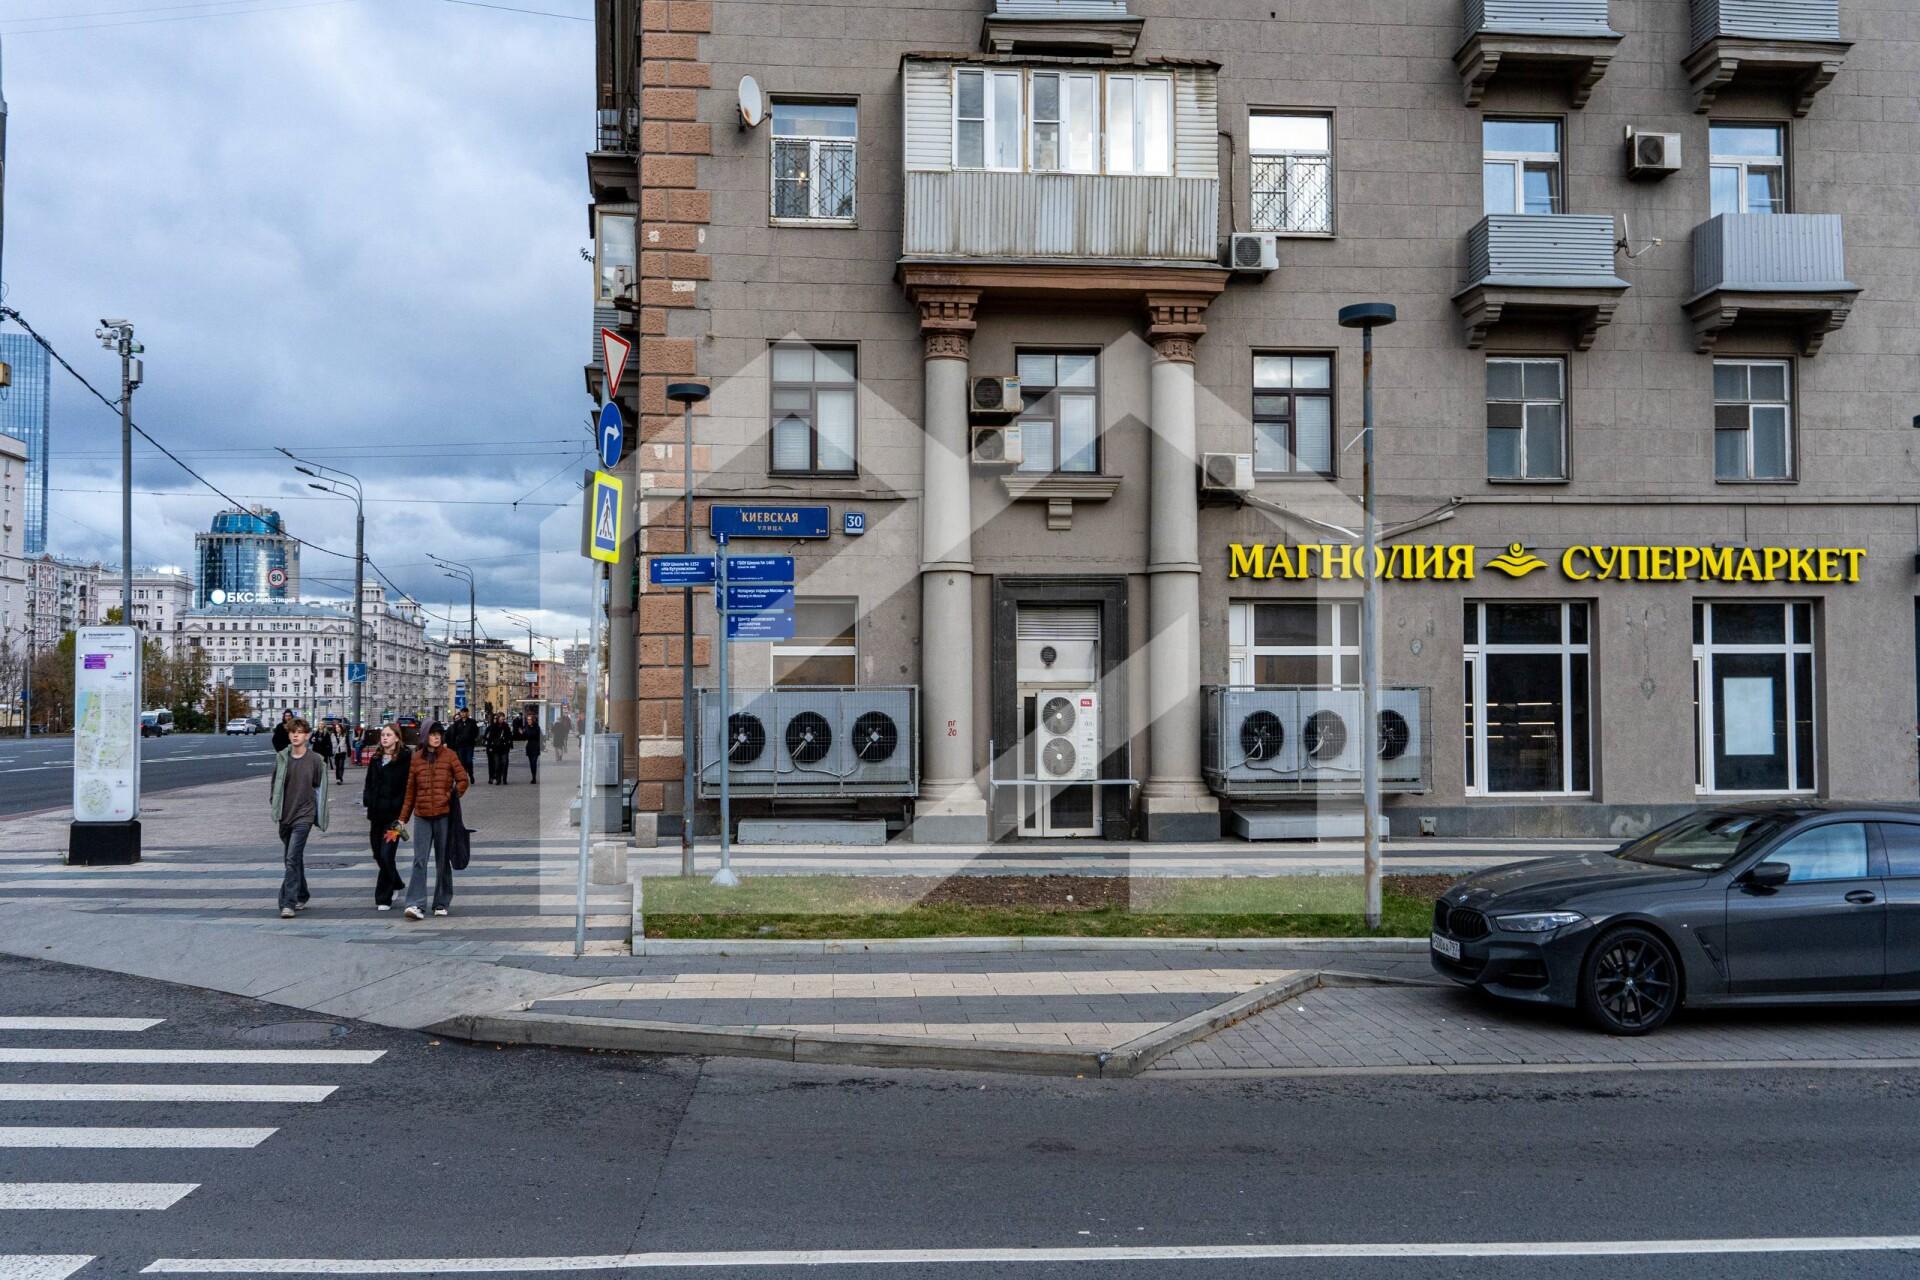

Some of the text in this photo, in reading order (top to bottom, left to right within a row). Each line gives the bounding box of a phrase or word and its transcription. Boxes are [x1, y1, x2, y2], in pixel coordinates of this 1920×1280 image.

[742, 512, 798, 522] КИЕВСКАЯ
[848, 515, 862, 528] 30
[1228, 544, 1867, 582] МАГНОЛИЯ СУПЕРМАРКЕТ
[227, 592, 254, 602] БКС
[948, 728, 958, 736] 20
